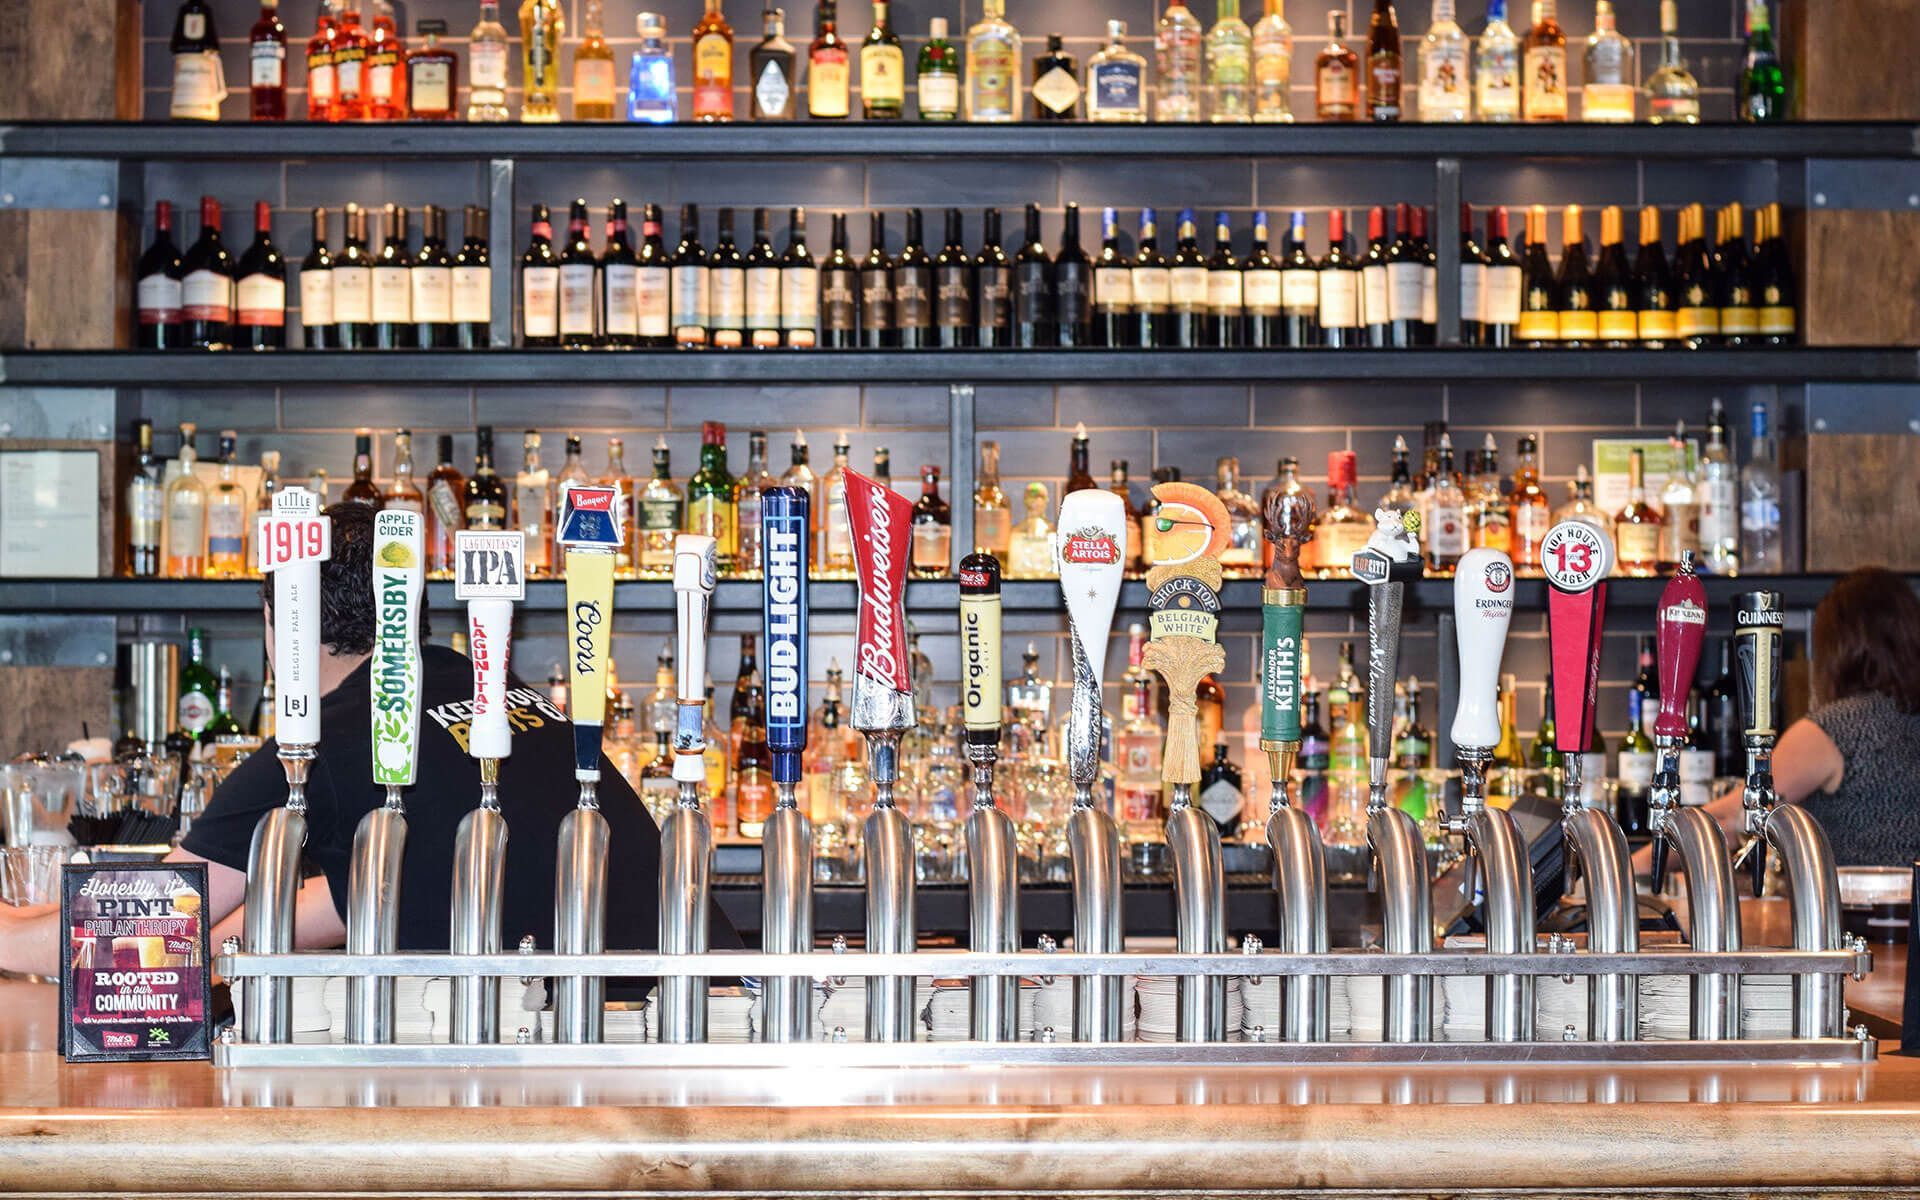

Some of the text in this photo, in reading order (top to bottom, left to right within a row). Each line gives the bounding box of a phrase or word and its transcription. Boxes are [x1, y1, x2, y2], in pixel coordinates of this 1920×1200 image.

[278, 491, 311, 507] LITTLE
[576, 493, 608, 507] Banquet
[378, 514, 415, 525] APPLE
[379, 525, 413, 537] CIDER
[263, 521, 322, 565] 1919
[464, 538, 510, 550] LAGUNITAS
[1072, 541, 1110, 550] STELLA
[1547, 528, 1599, 556] HOP HOUSE
[1072, 549, 1110, 559] ARTOIS
[1553, 543, 1592, 573] 13
[462, 550, 519, 585] IPA
[1554, 570, 1591, 584] LAGER
[861, 486, 897, 690] Budweiser
[1152, 579, 1193, 608] SHOCK
[770, 527, 799, 717] BUD LIGHT
[1157, 612, 1210, 626] BELGIAN
[1737, 610, 1784, 625] GUINNESS
[575, 599, 602, 675] Coors
[1163, 623, 1204, 634] WHITE
[472, 617, 489, 715] LAGUNITAS
[967, 612, 984, 708] Organic
[1268, 649, 1277, 701] ALEXANDER
[1275, 637, 1295, 711] KEITH'S
[80, 878, 188, 898] Honestly, it's
[96, 898, 174, 917] PINT
[84, 919, 189, 937] PHILANTHROPY
[95, 972, 179, 986] ROOTED
[120, 984, 152, 994] in our
[95, 994, 179, 1012] COMMUNITY
